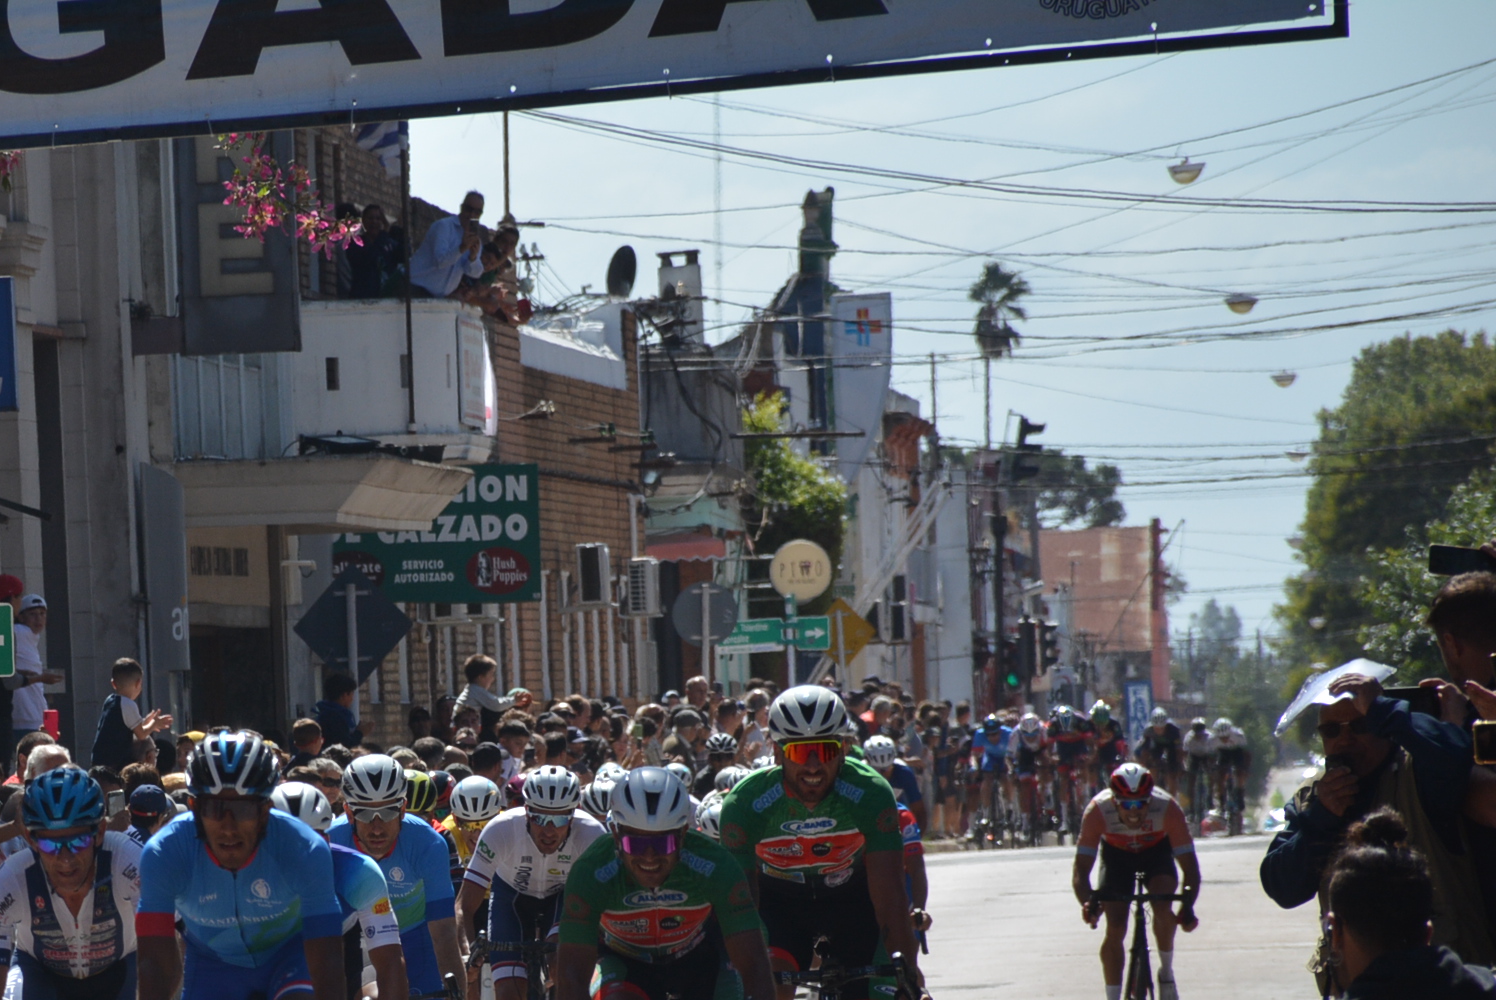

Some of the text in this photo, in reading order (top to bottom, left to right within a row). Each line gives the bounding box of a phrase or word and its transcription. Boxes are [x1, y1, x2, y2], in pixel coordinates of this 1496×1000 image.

[402, 559, 444, 571] SERVICIO
[492, 557, 516, 570] Hush
[394, 569, 528, 585] AUTORIZADO Puppies
